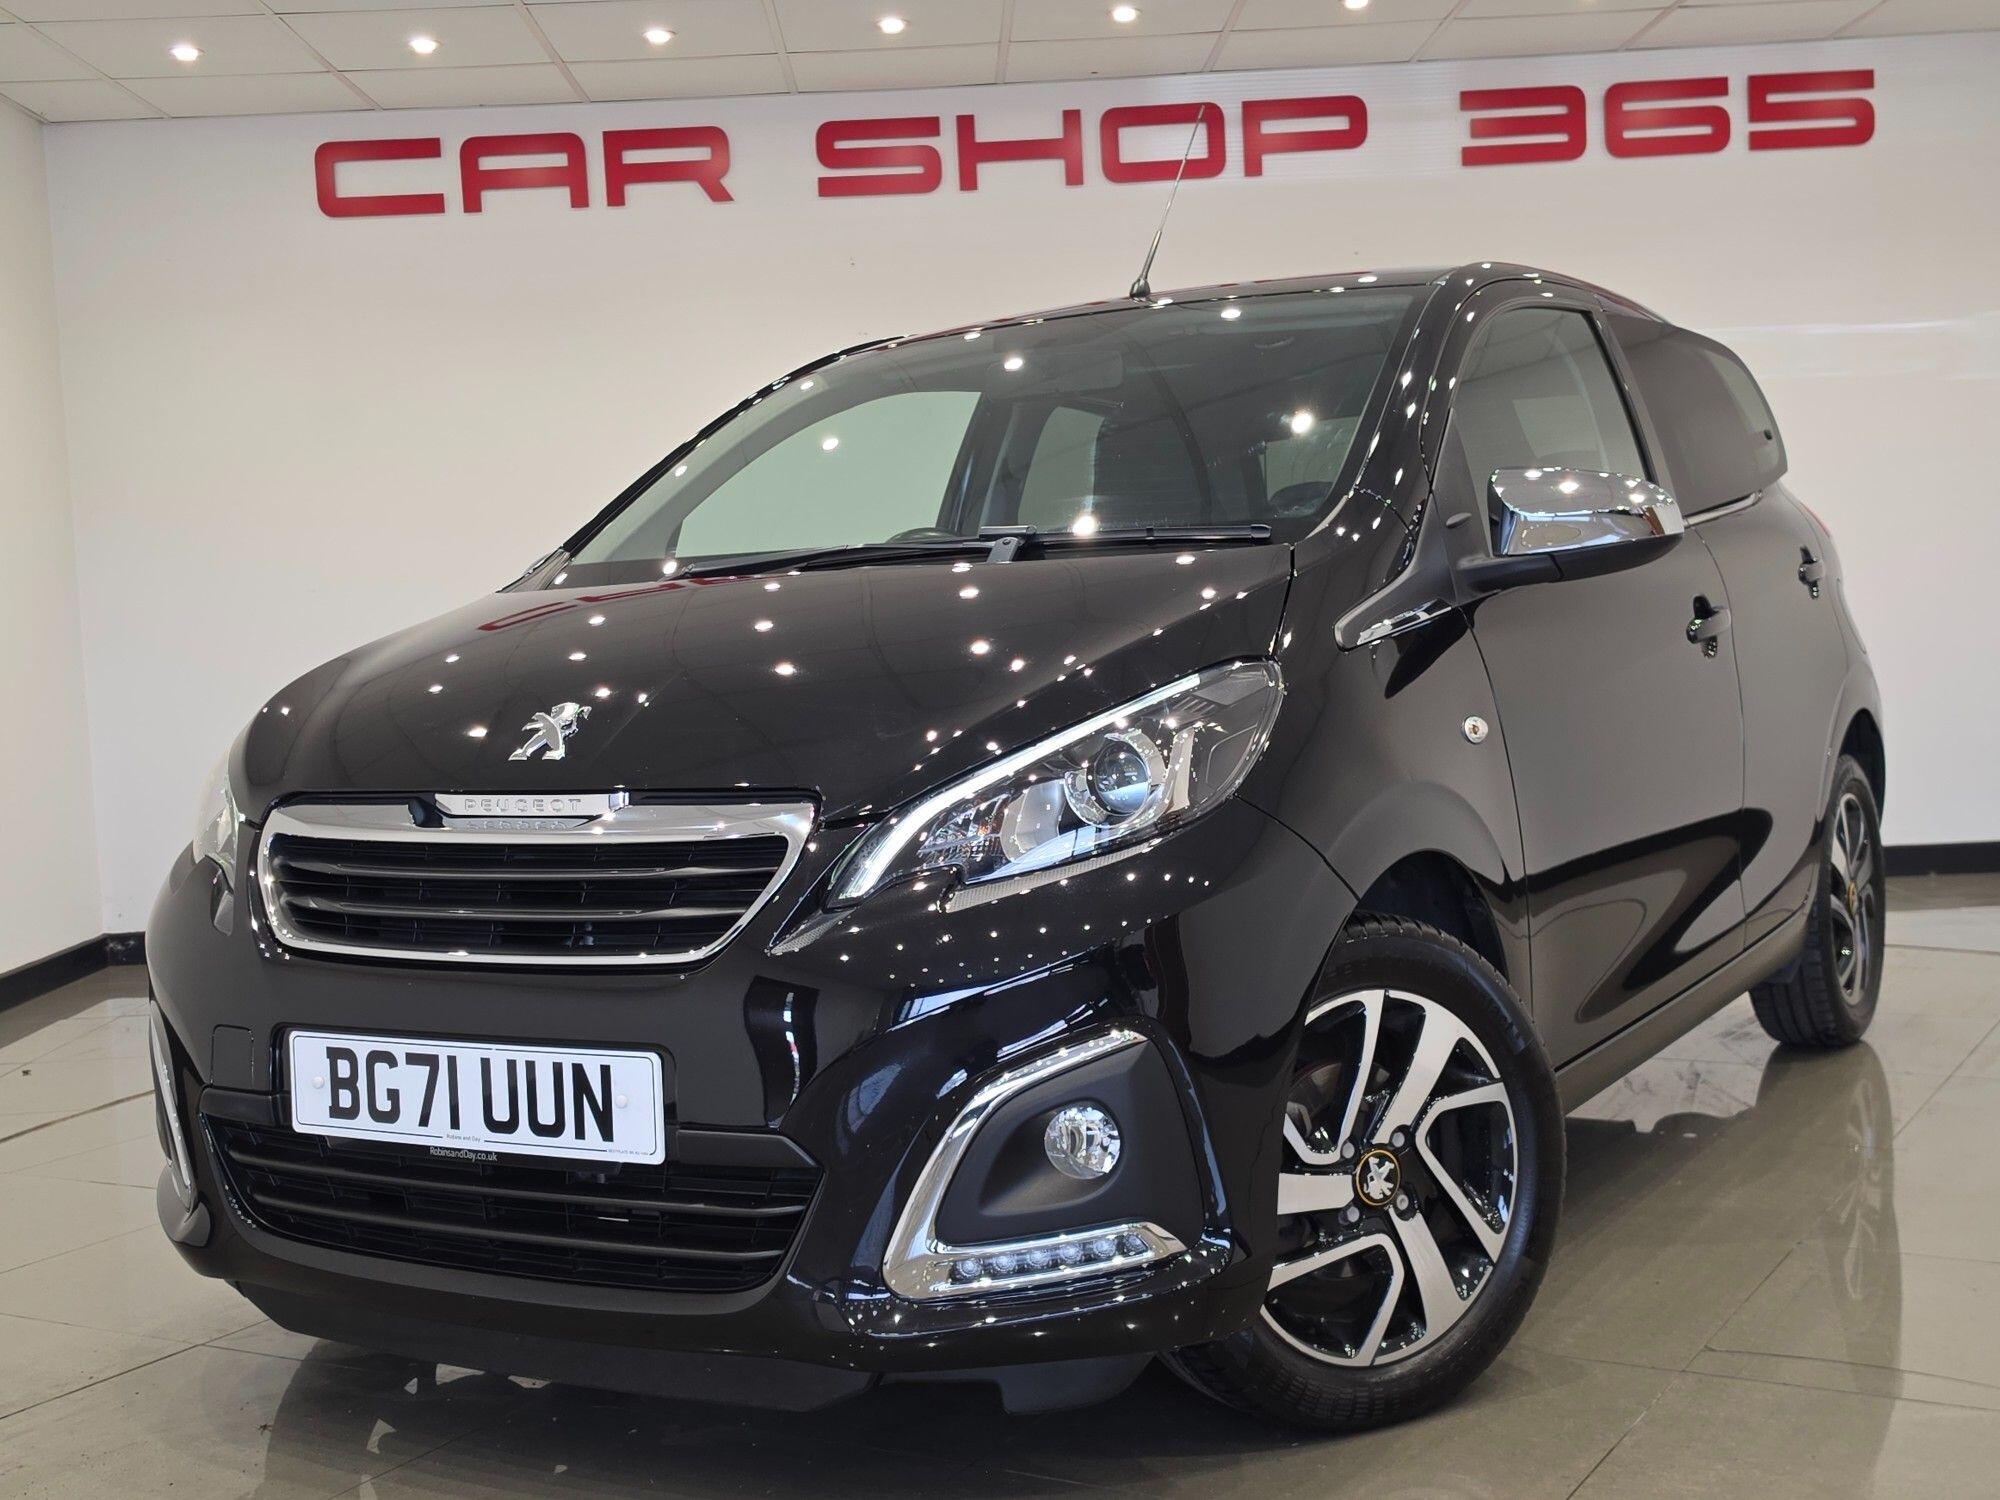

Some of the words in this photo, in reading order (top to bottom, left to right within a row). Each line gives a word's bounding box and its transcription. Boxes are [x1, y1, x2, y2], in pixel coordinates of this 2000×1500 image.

[314, 126, 734, 218] CAR
[815, 95, 1368, 197] SHOP
[1460, 69, 1875, 167] 365
[464, 798, 582, 813] PEUGEOT
[326, 1046, 461, 1131] BG71
[480, 1057, 614, 1143] UUN
[429, 1146, 498, 1162] RobinsandDay.co.uk
